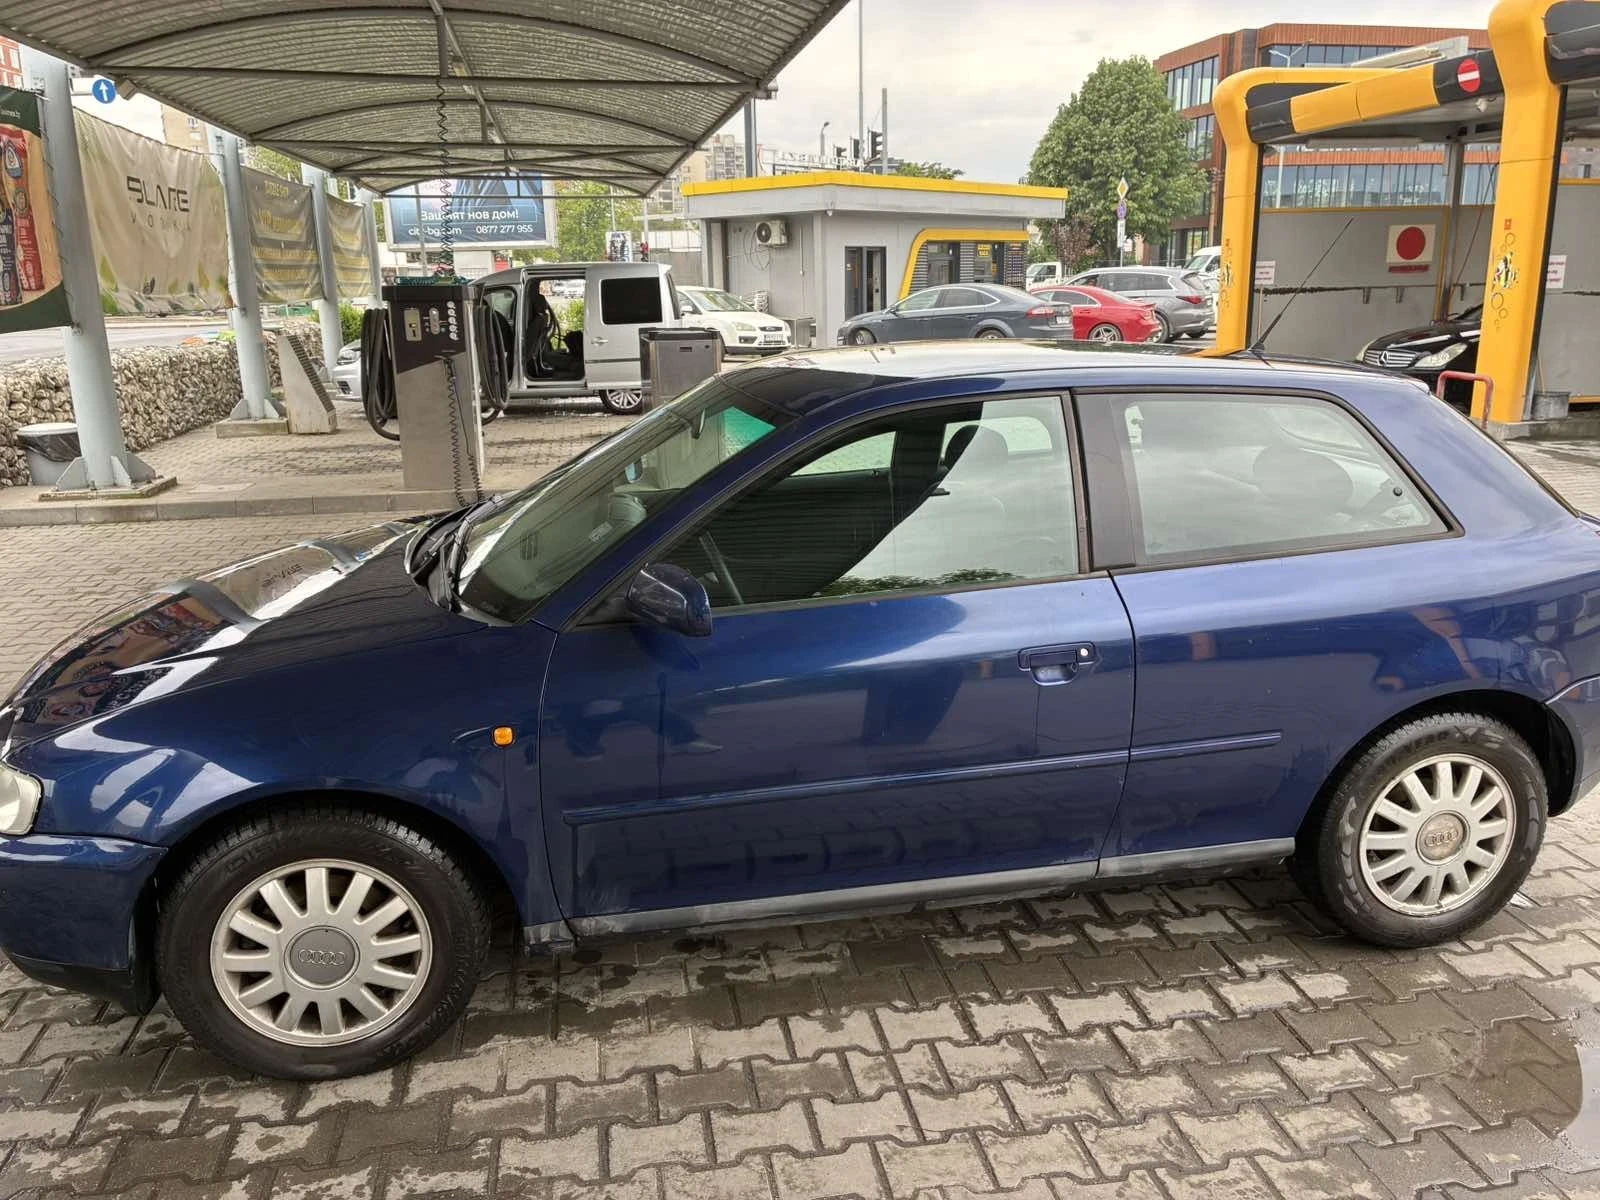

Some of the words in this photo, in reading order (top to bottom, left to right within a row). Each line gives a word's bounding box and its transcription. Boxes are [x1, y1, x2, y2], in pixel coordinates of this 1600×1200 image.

[467, 211, 490, 220] нов
[492, 208, 519, 220] дом!
[499, 224, 515, 233] 277
[516, 224, 534, 233] 955
